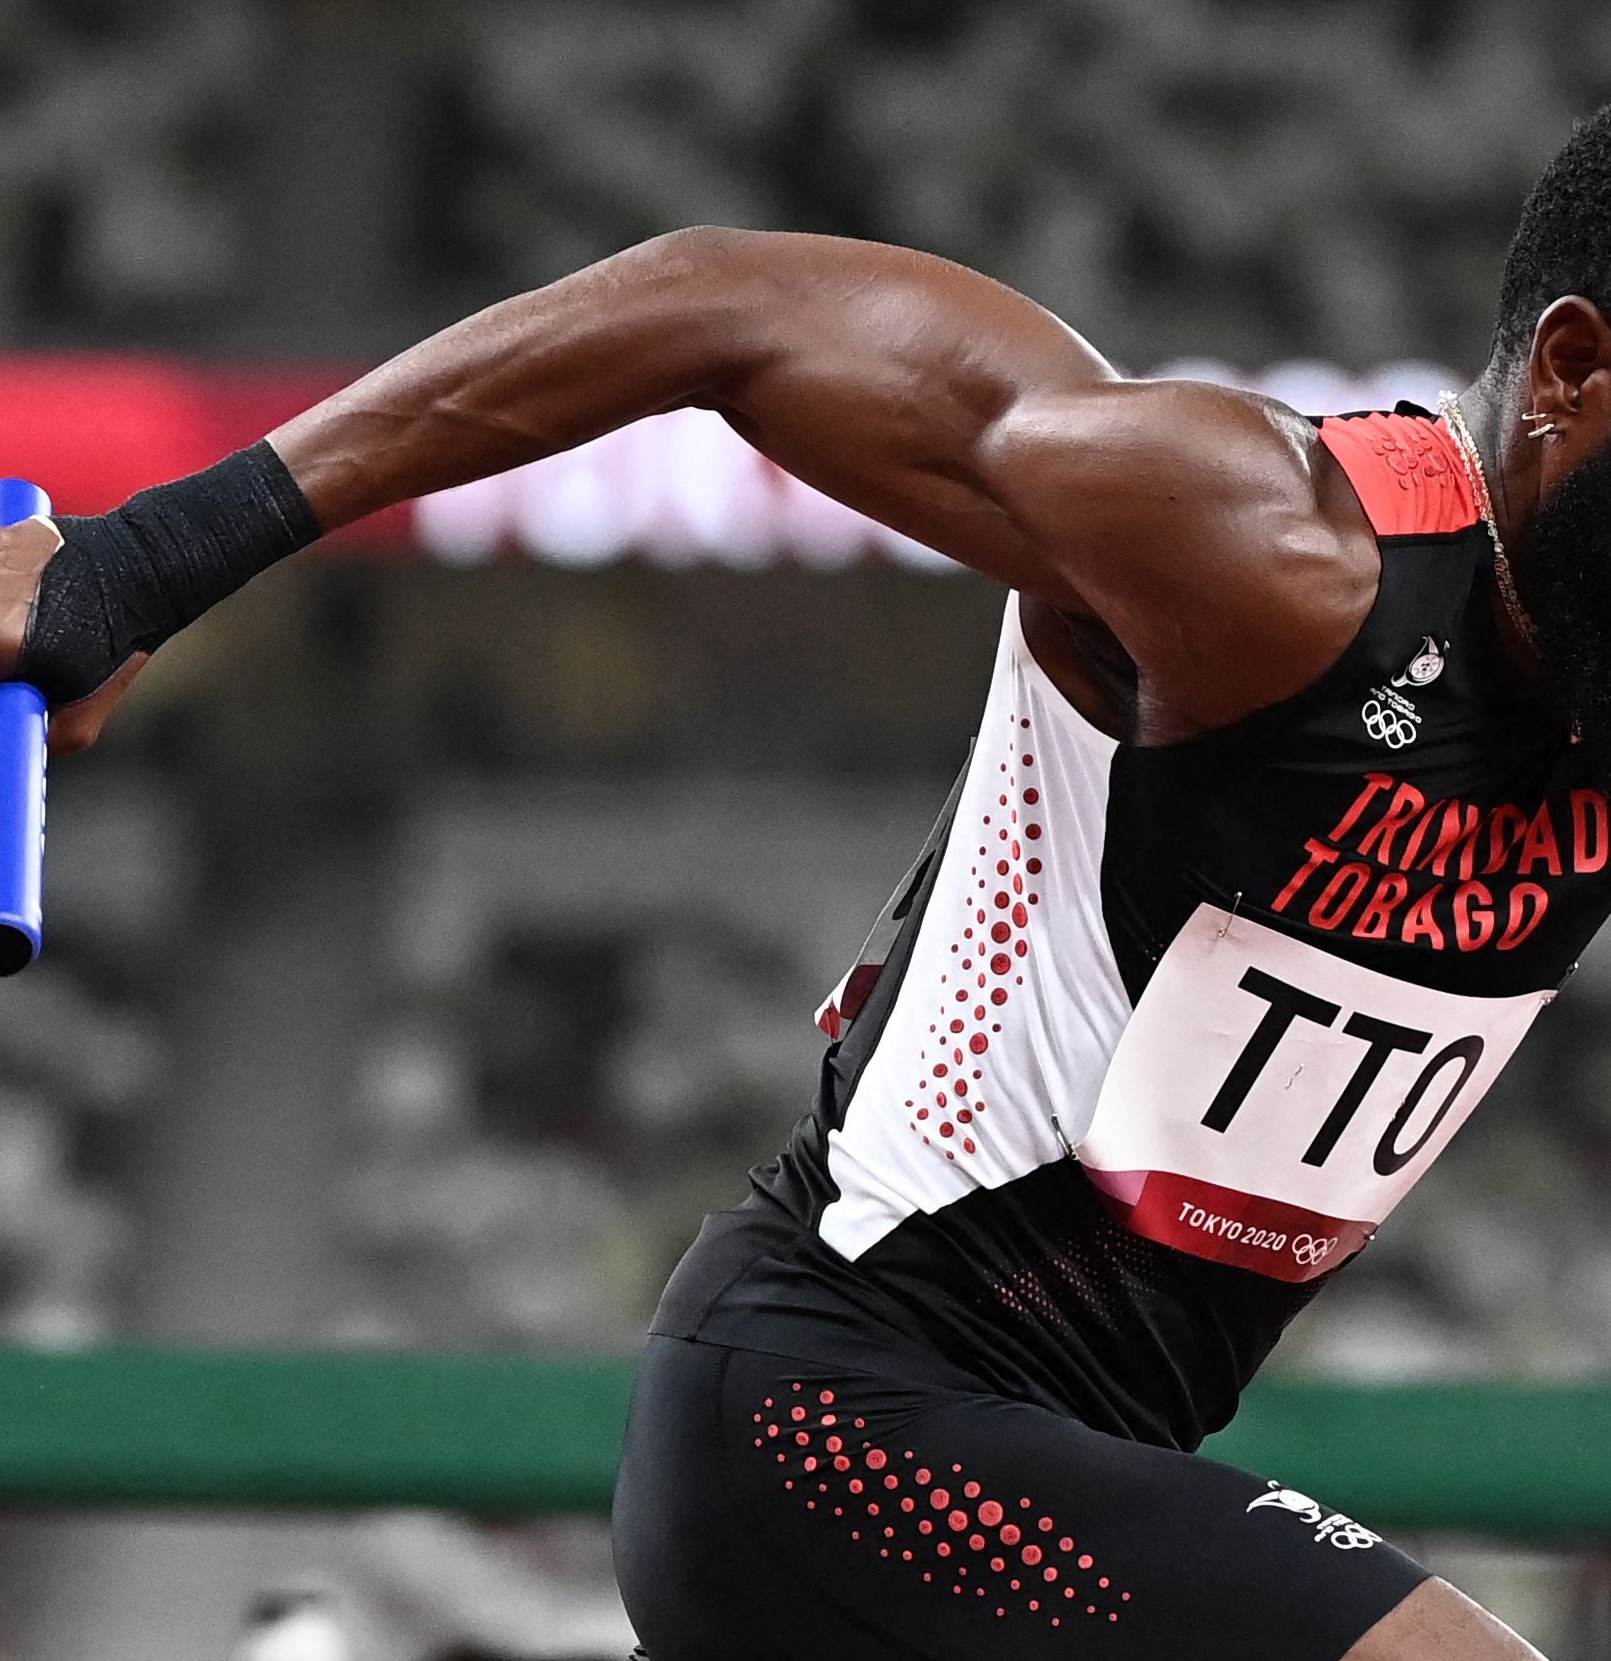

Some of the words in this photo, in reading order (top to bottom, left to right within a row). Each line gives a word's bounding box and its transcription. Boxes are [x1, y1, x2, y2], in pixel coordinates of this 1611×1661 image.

[1327, 772, 1609, 881] TRINIDAD
[1270, 837, 1549, 952] TOBAGO
[1200, 965, 1485, 1176] TTO
[1178, 1201, 1243, 1240] TOKYO
[1240, 1226, 1287, 1251] 2020
